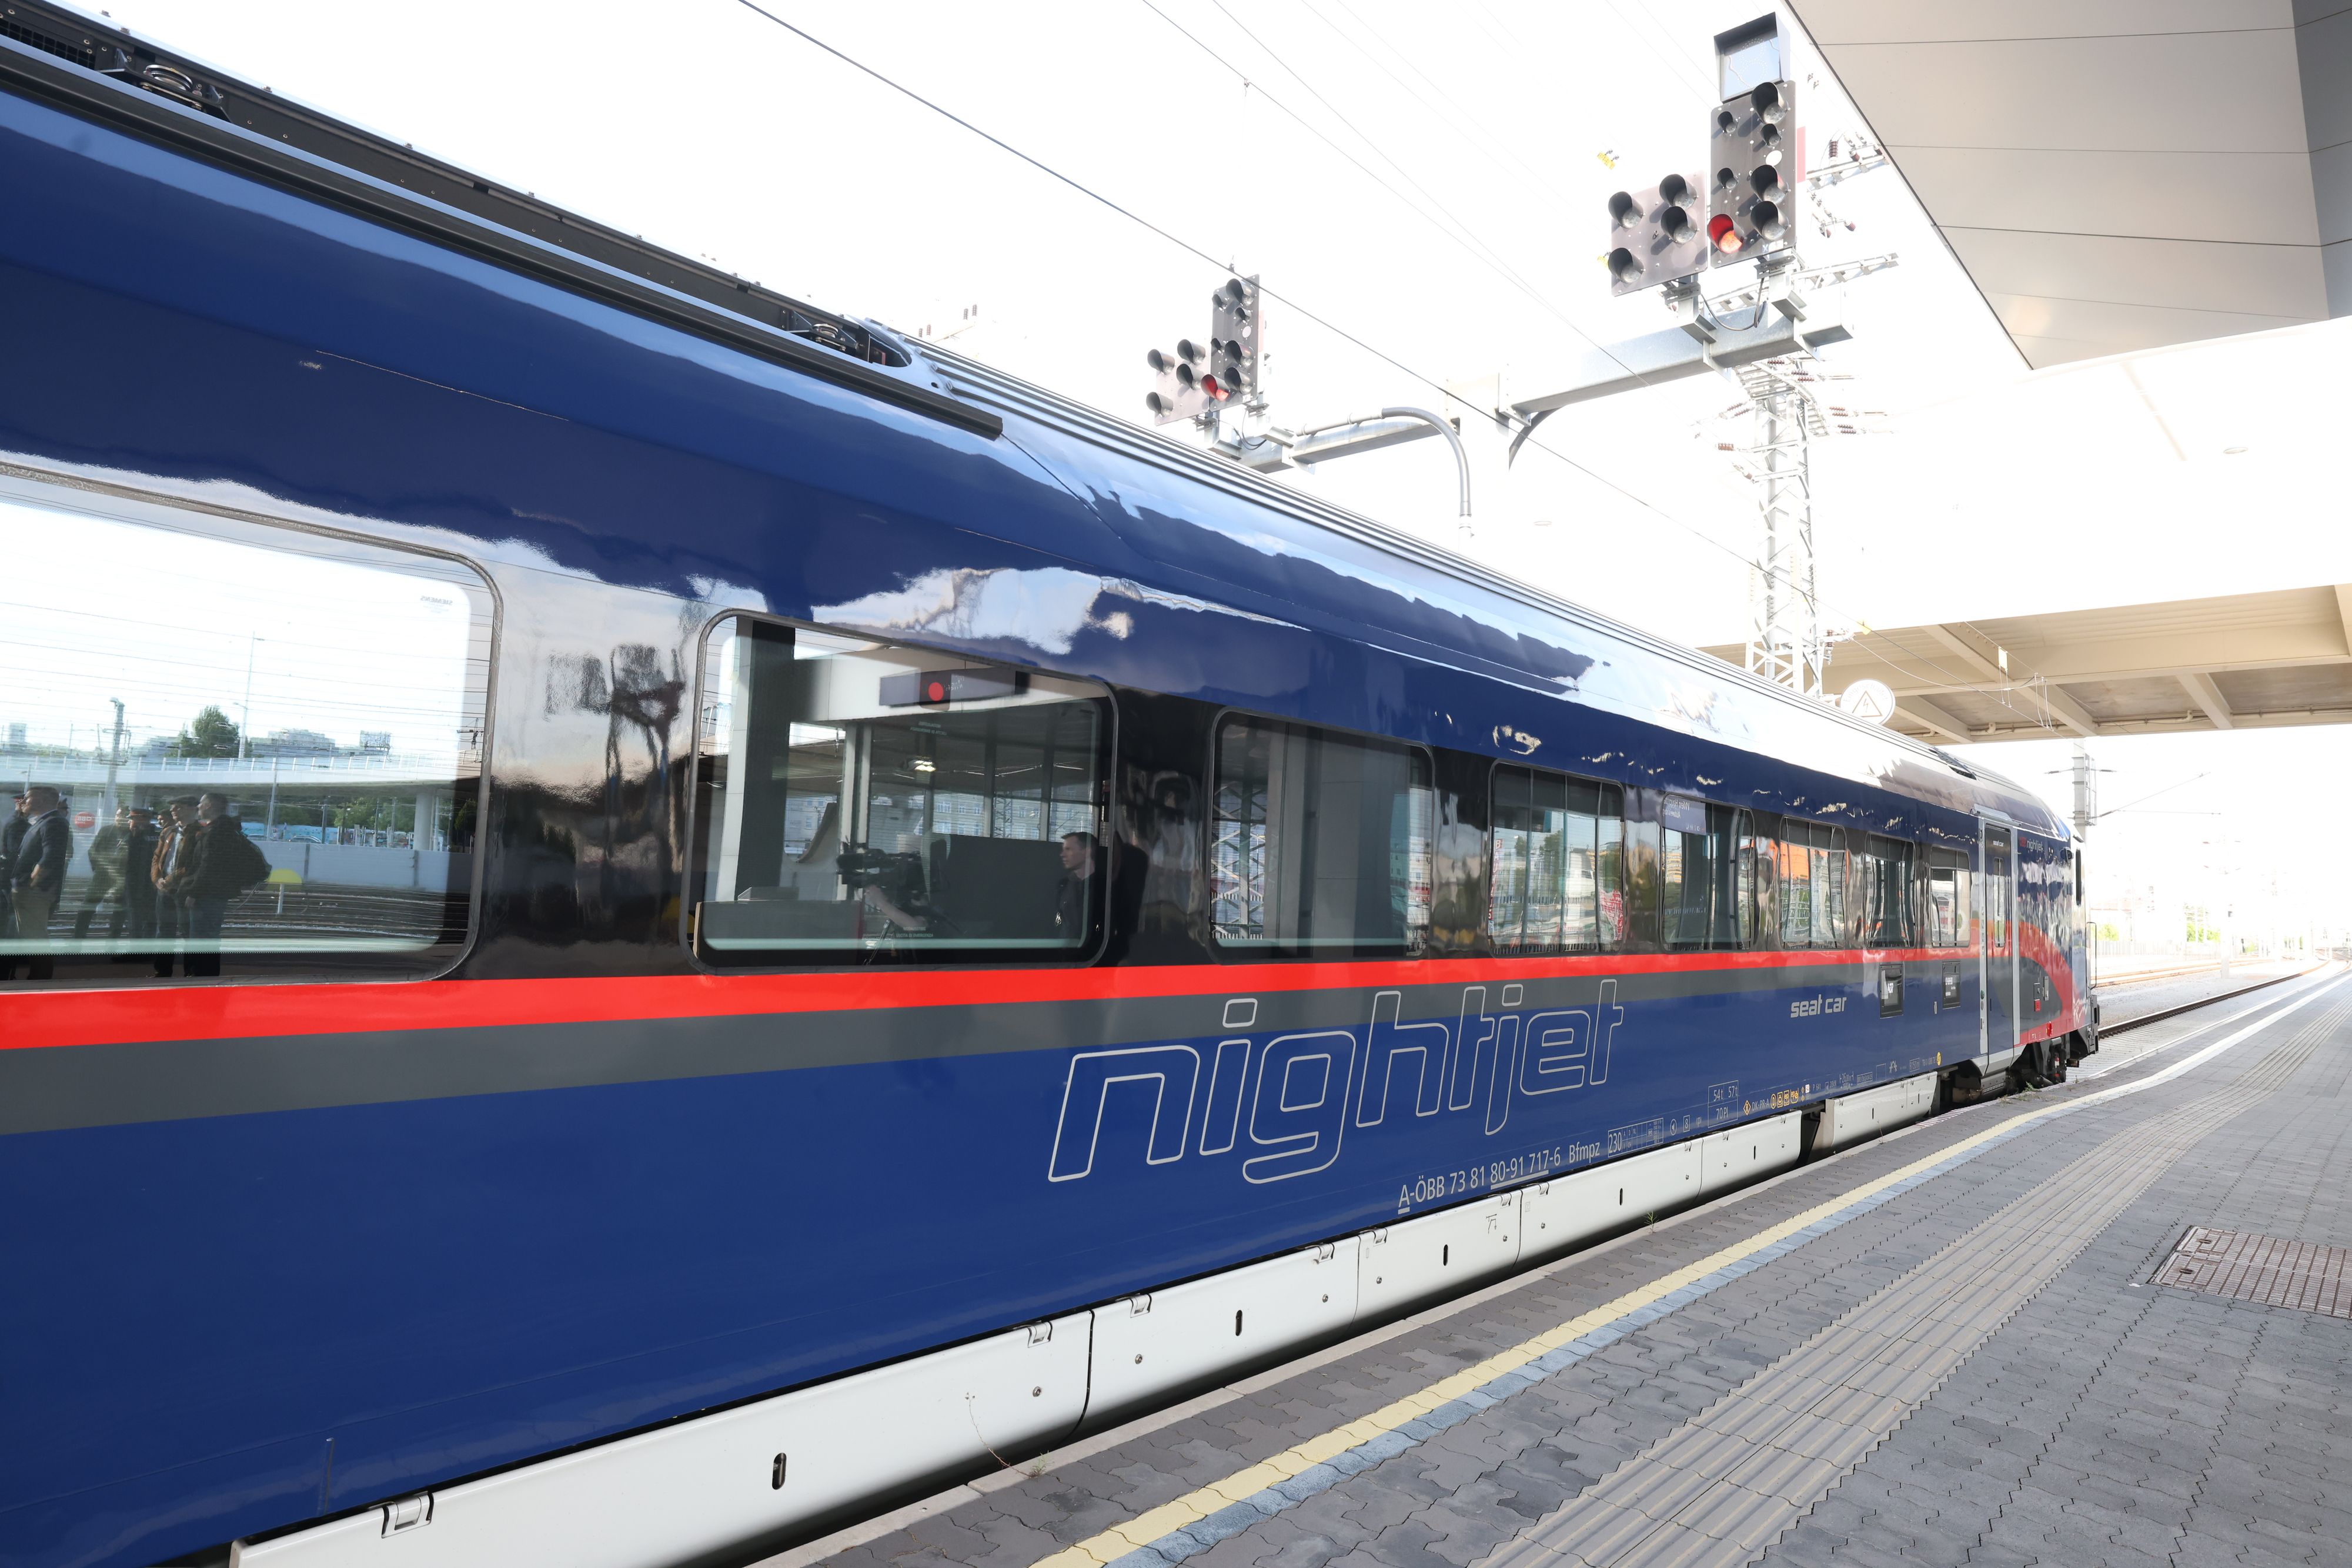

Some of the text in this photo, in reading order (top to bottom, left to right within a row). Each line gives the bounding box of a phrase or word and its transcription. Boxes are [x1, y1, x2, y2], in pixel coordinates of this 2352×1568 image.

[2026, 838, 2043, 853] nightjet
[1790, 994, 1847, 1018] seat car
[1048, 978, 1624, 1184] nightjet
[1685, 1118, 1688, 1129] 8
[1609, 1132, 1622, 1154] 230
[1398, 1141, 1600, 1208] A-ÖBB 73 81 80-91 717-6 Bfmpz
